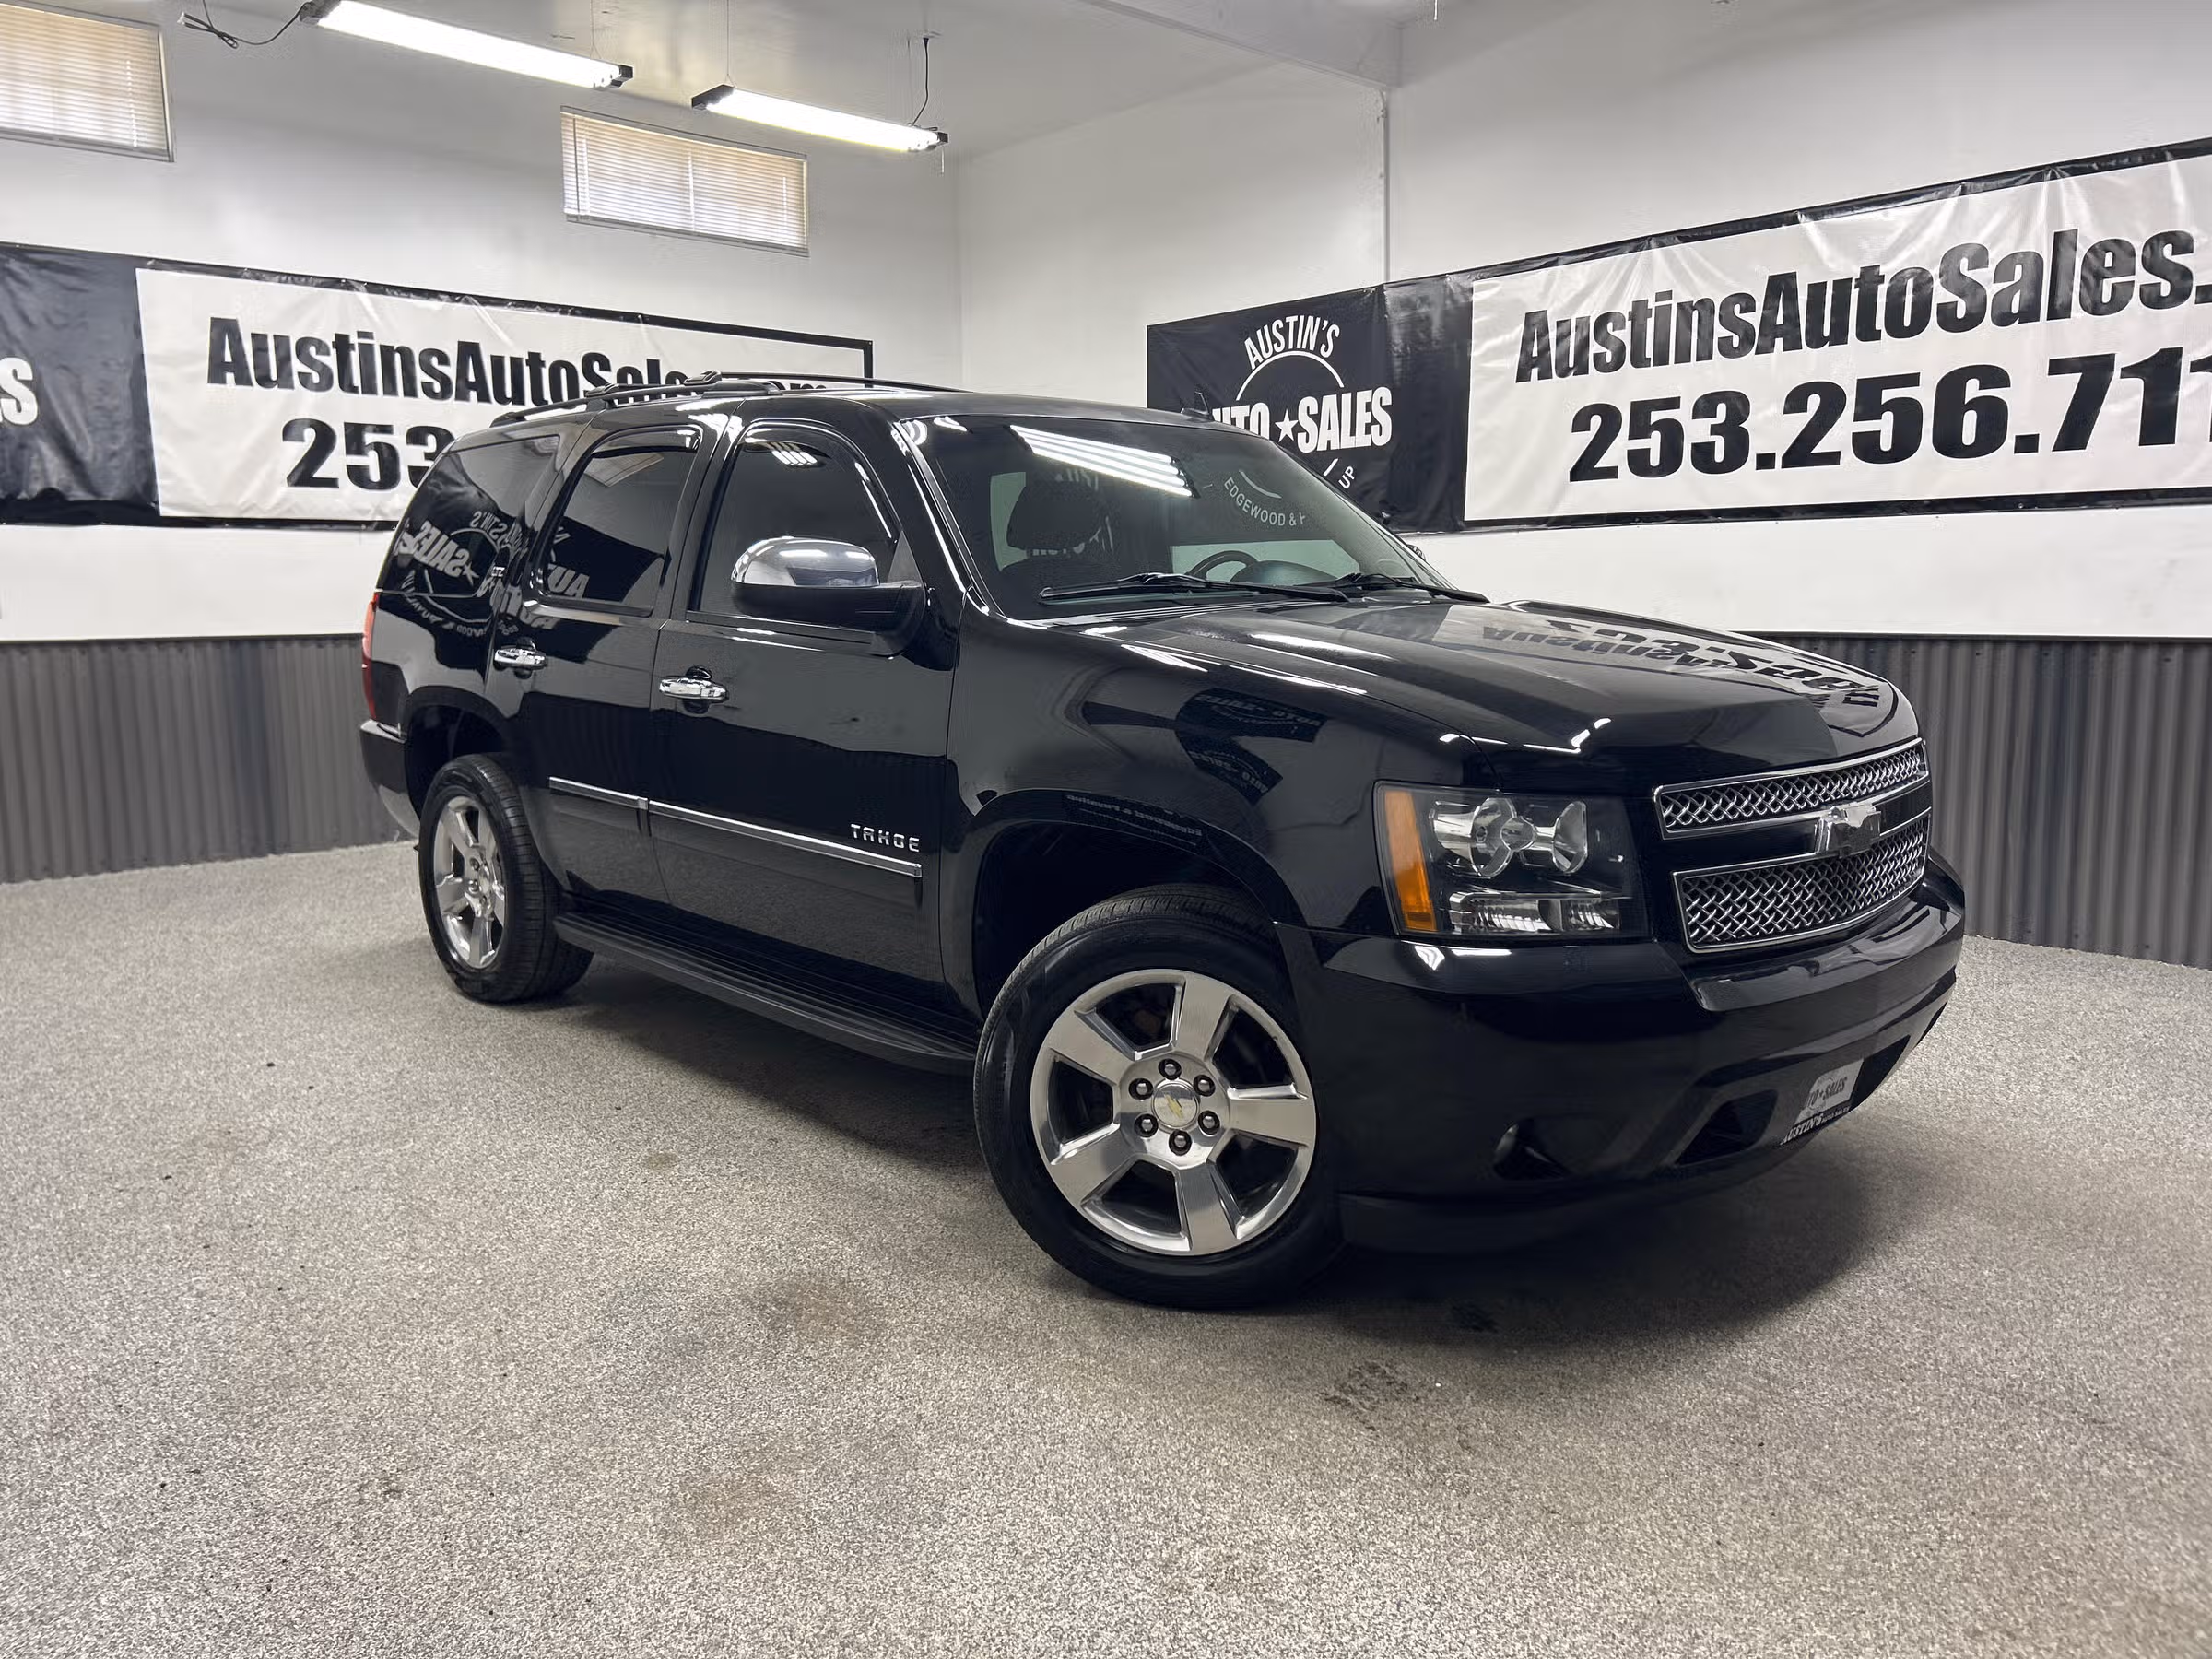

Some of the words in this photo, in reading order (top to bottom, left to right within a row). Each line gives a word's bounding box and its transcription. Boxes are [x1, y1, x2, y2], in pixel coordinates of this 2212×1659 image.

[1244, 315, 1340, 370] AUSTIN'S
[1298, 386, 1393, 453] SALES
[1223, 477, 1286, 526] EDGEWOOD
[851, 823, 920, 853] TAHOE
